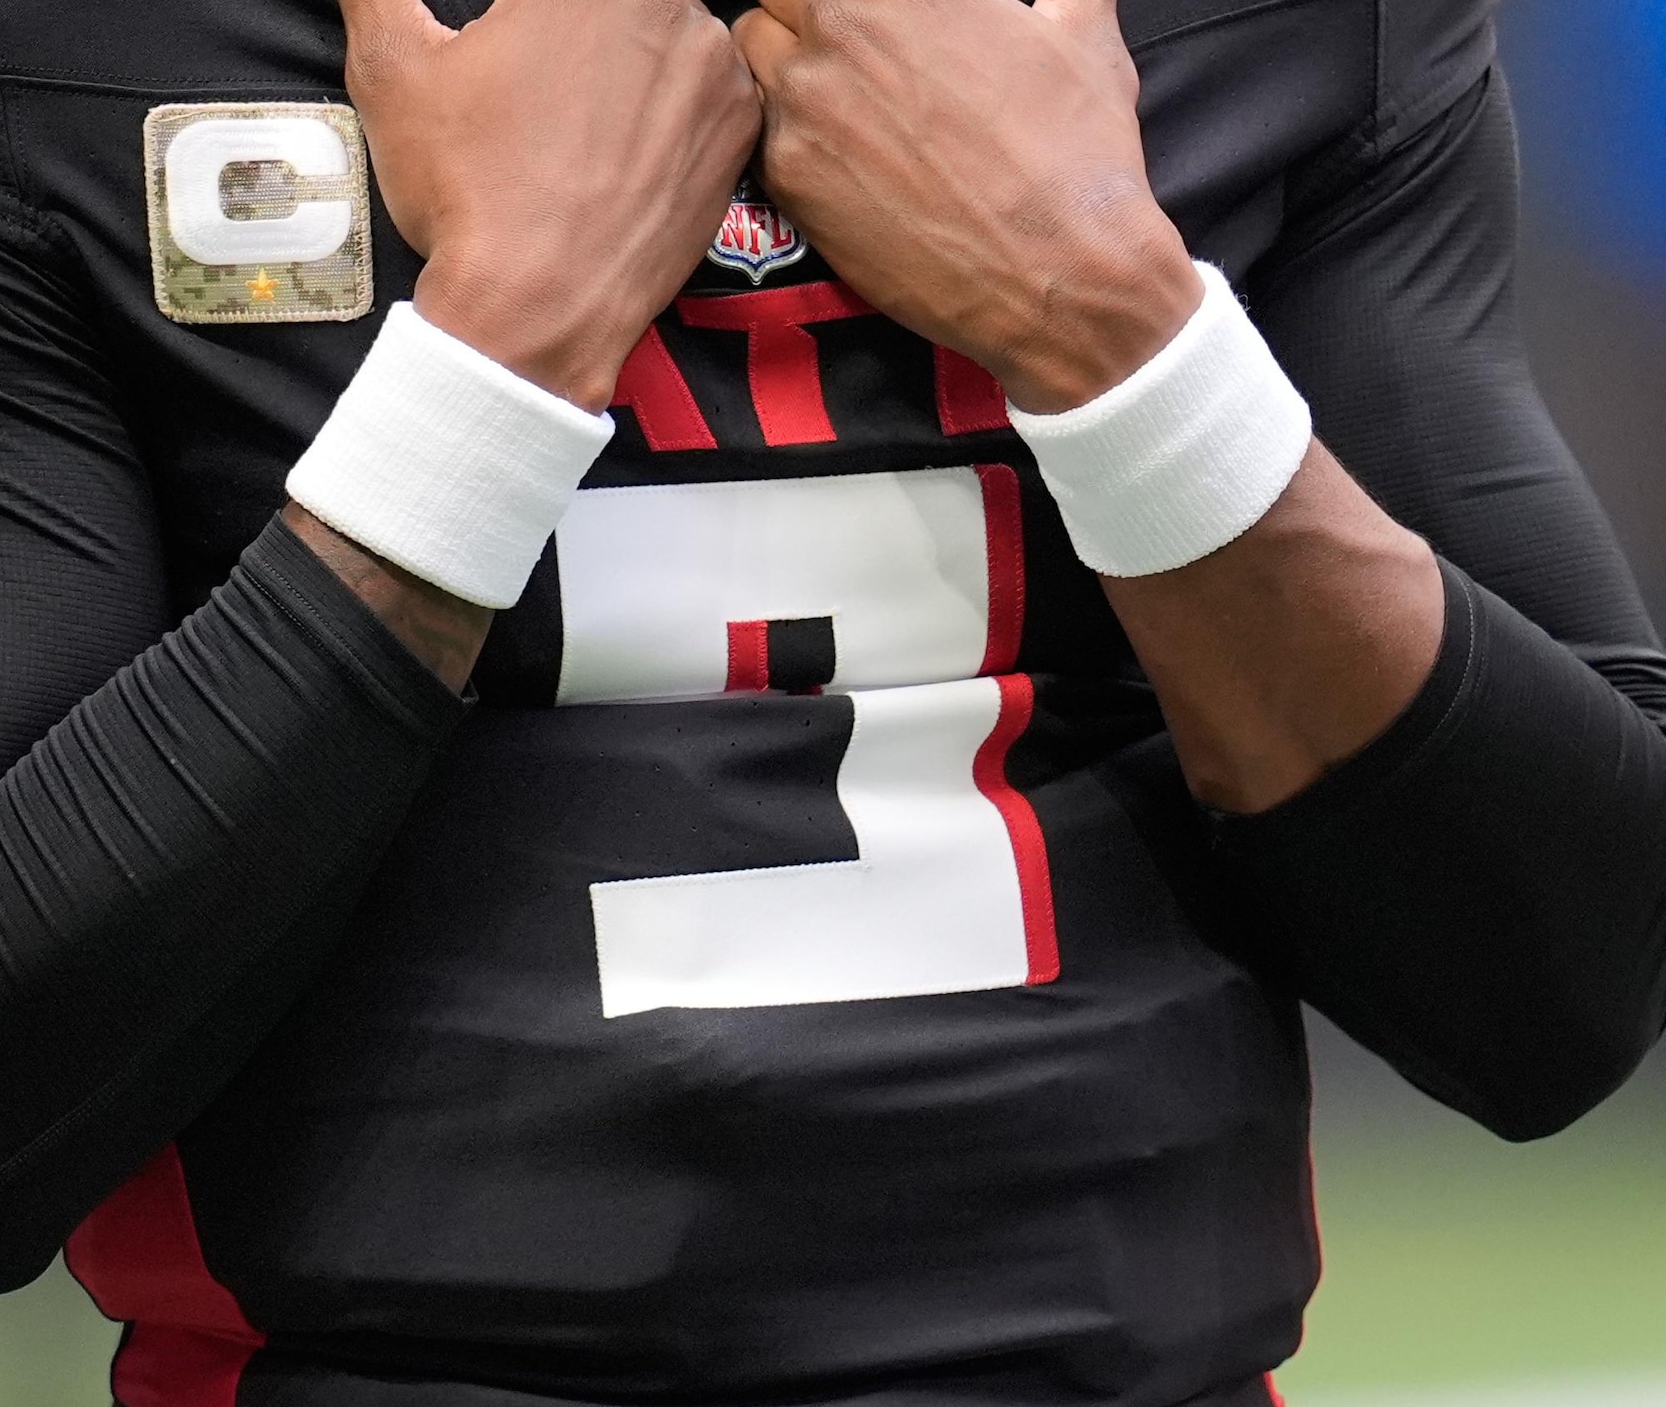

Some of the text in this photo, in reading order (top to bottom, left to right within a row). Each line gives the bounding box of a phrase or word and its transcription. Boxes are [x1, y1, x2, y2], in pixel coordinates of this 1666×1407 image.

[165, 118, 352, 265] C
[721, 204, 792, 256] NFL
[554, 463, 1061, 1019] 9
